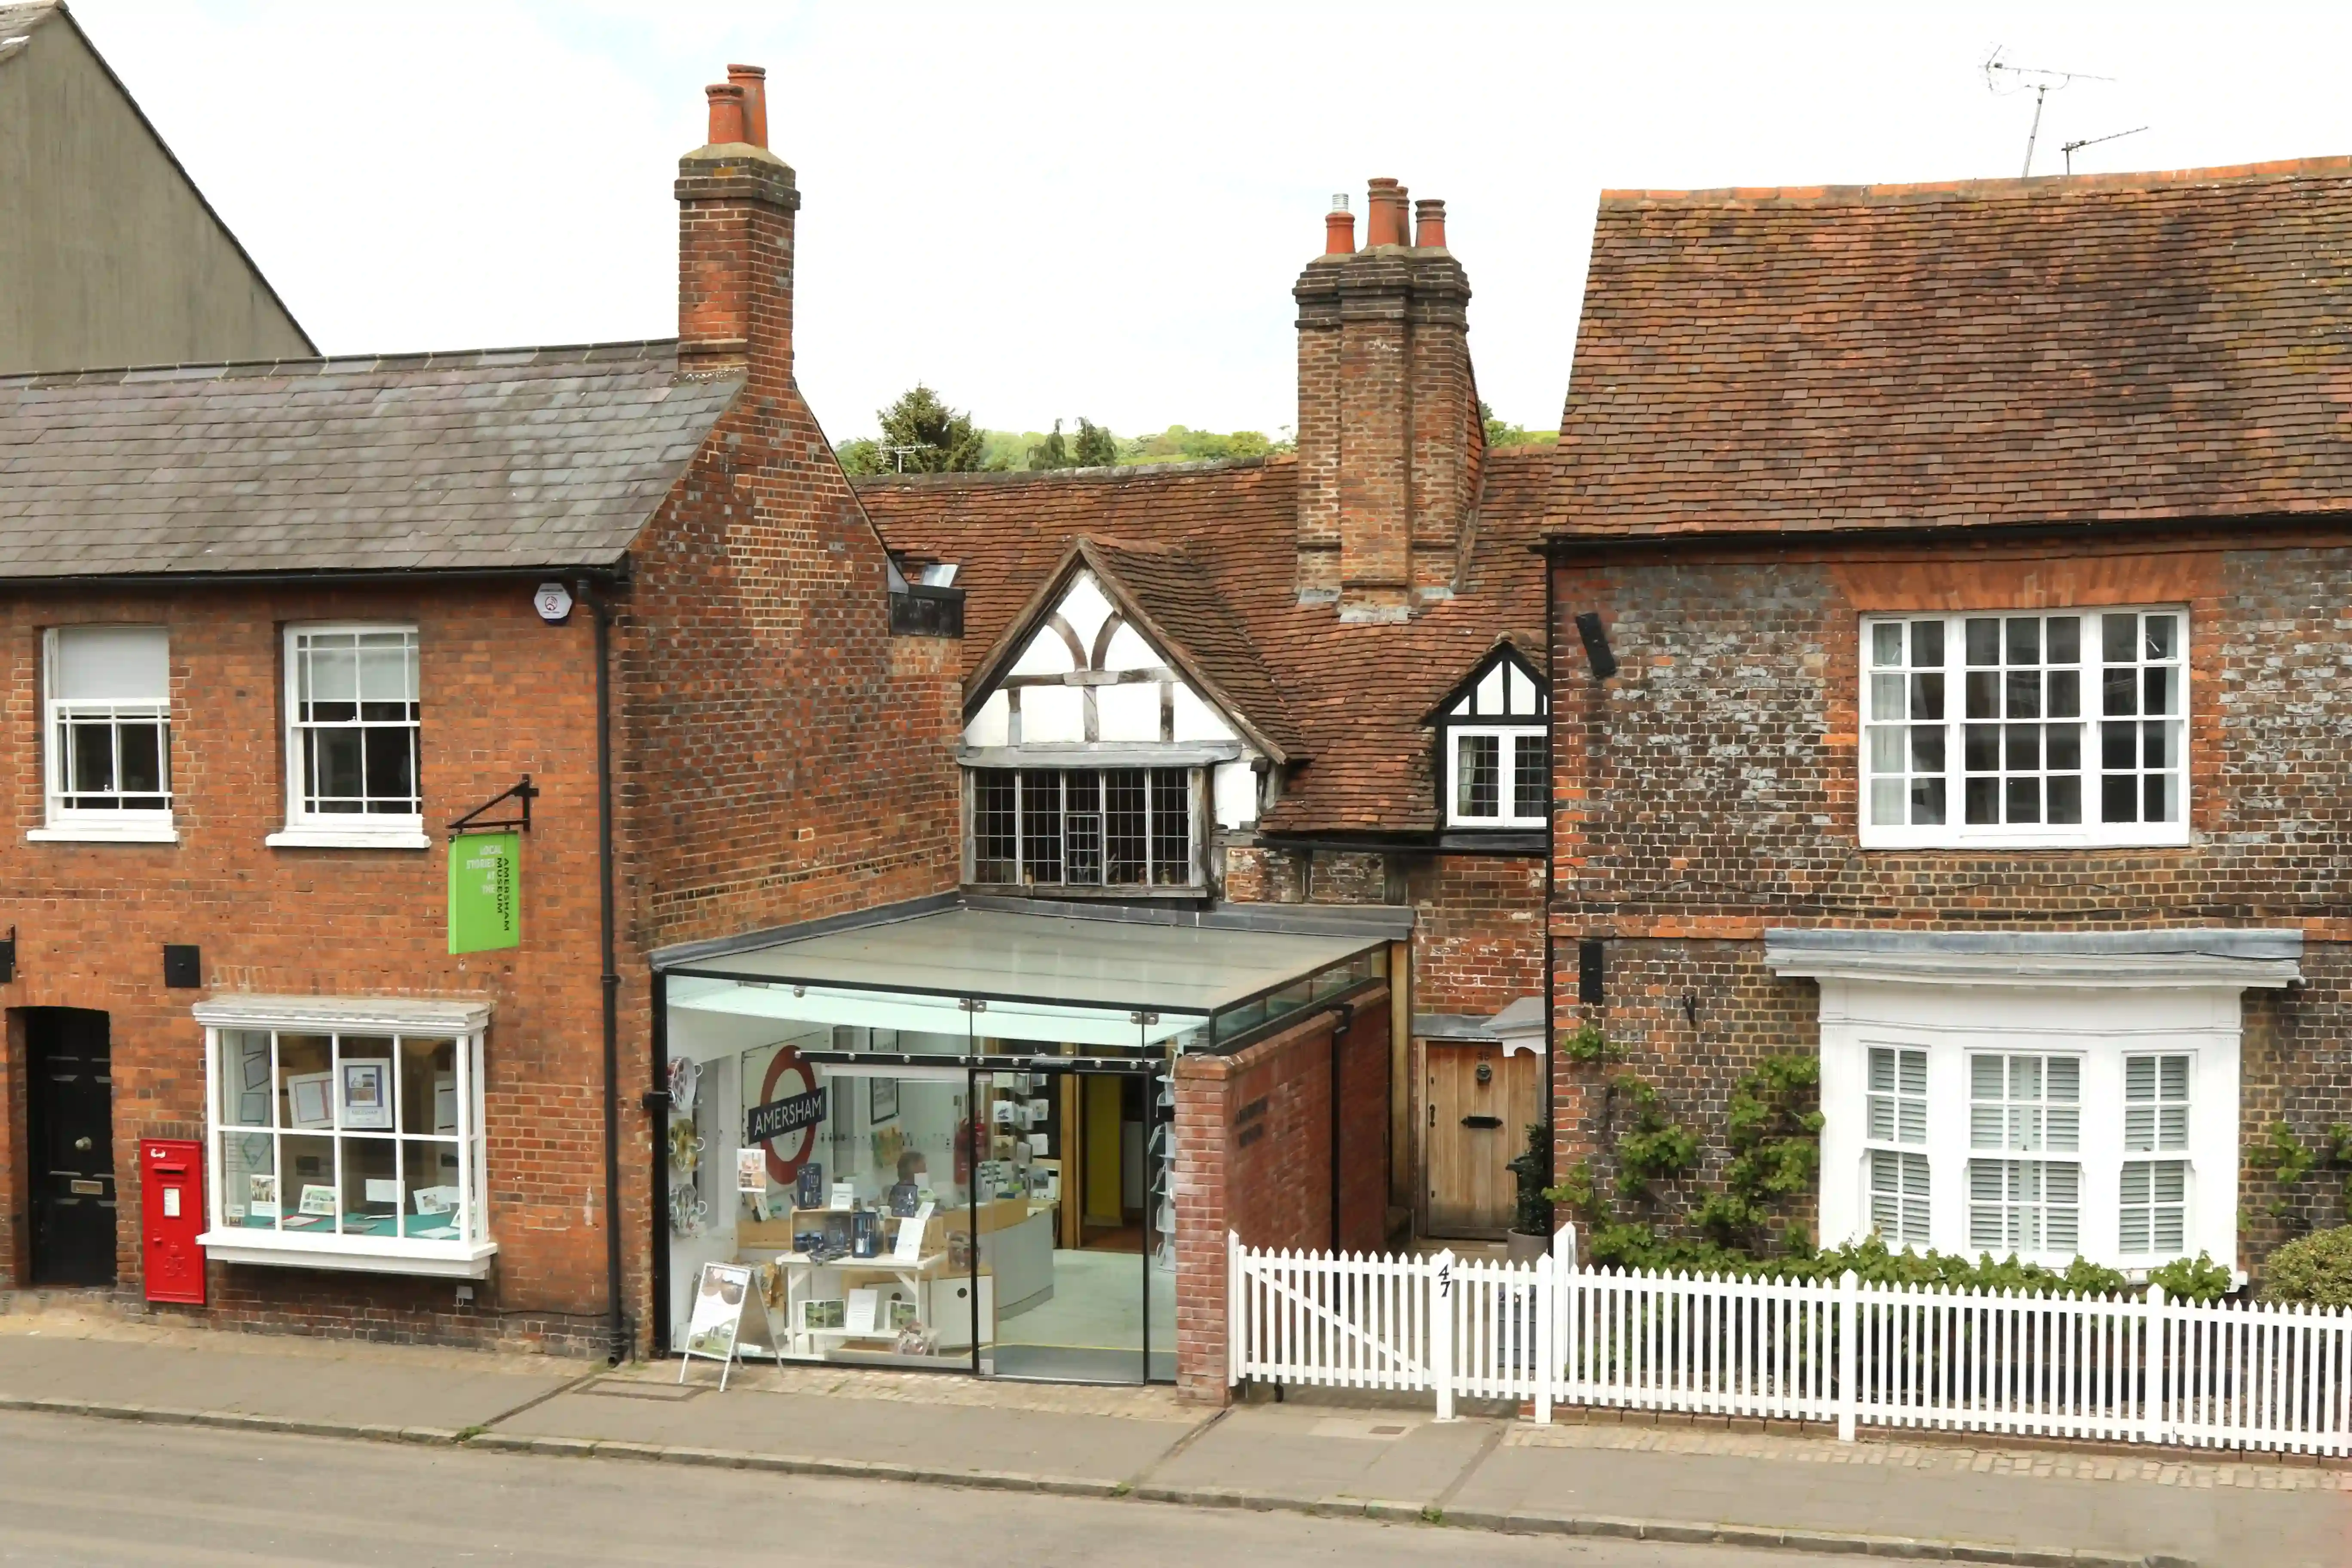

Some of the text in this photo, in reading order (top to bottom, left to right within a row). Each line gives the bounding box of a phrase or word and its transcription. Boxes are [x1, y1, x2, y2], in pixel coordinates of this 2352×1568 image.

[480, 845, 502, 855] LOCAL
[466, 858, 495, 870] STORIES
[487, 871, 495, 880] AT
[754, 1095, 822, 1136] AMERSHAM
